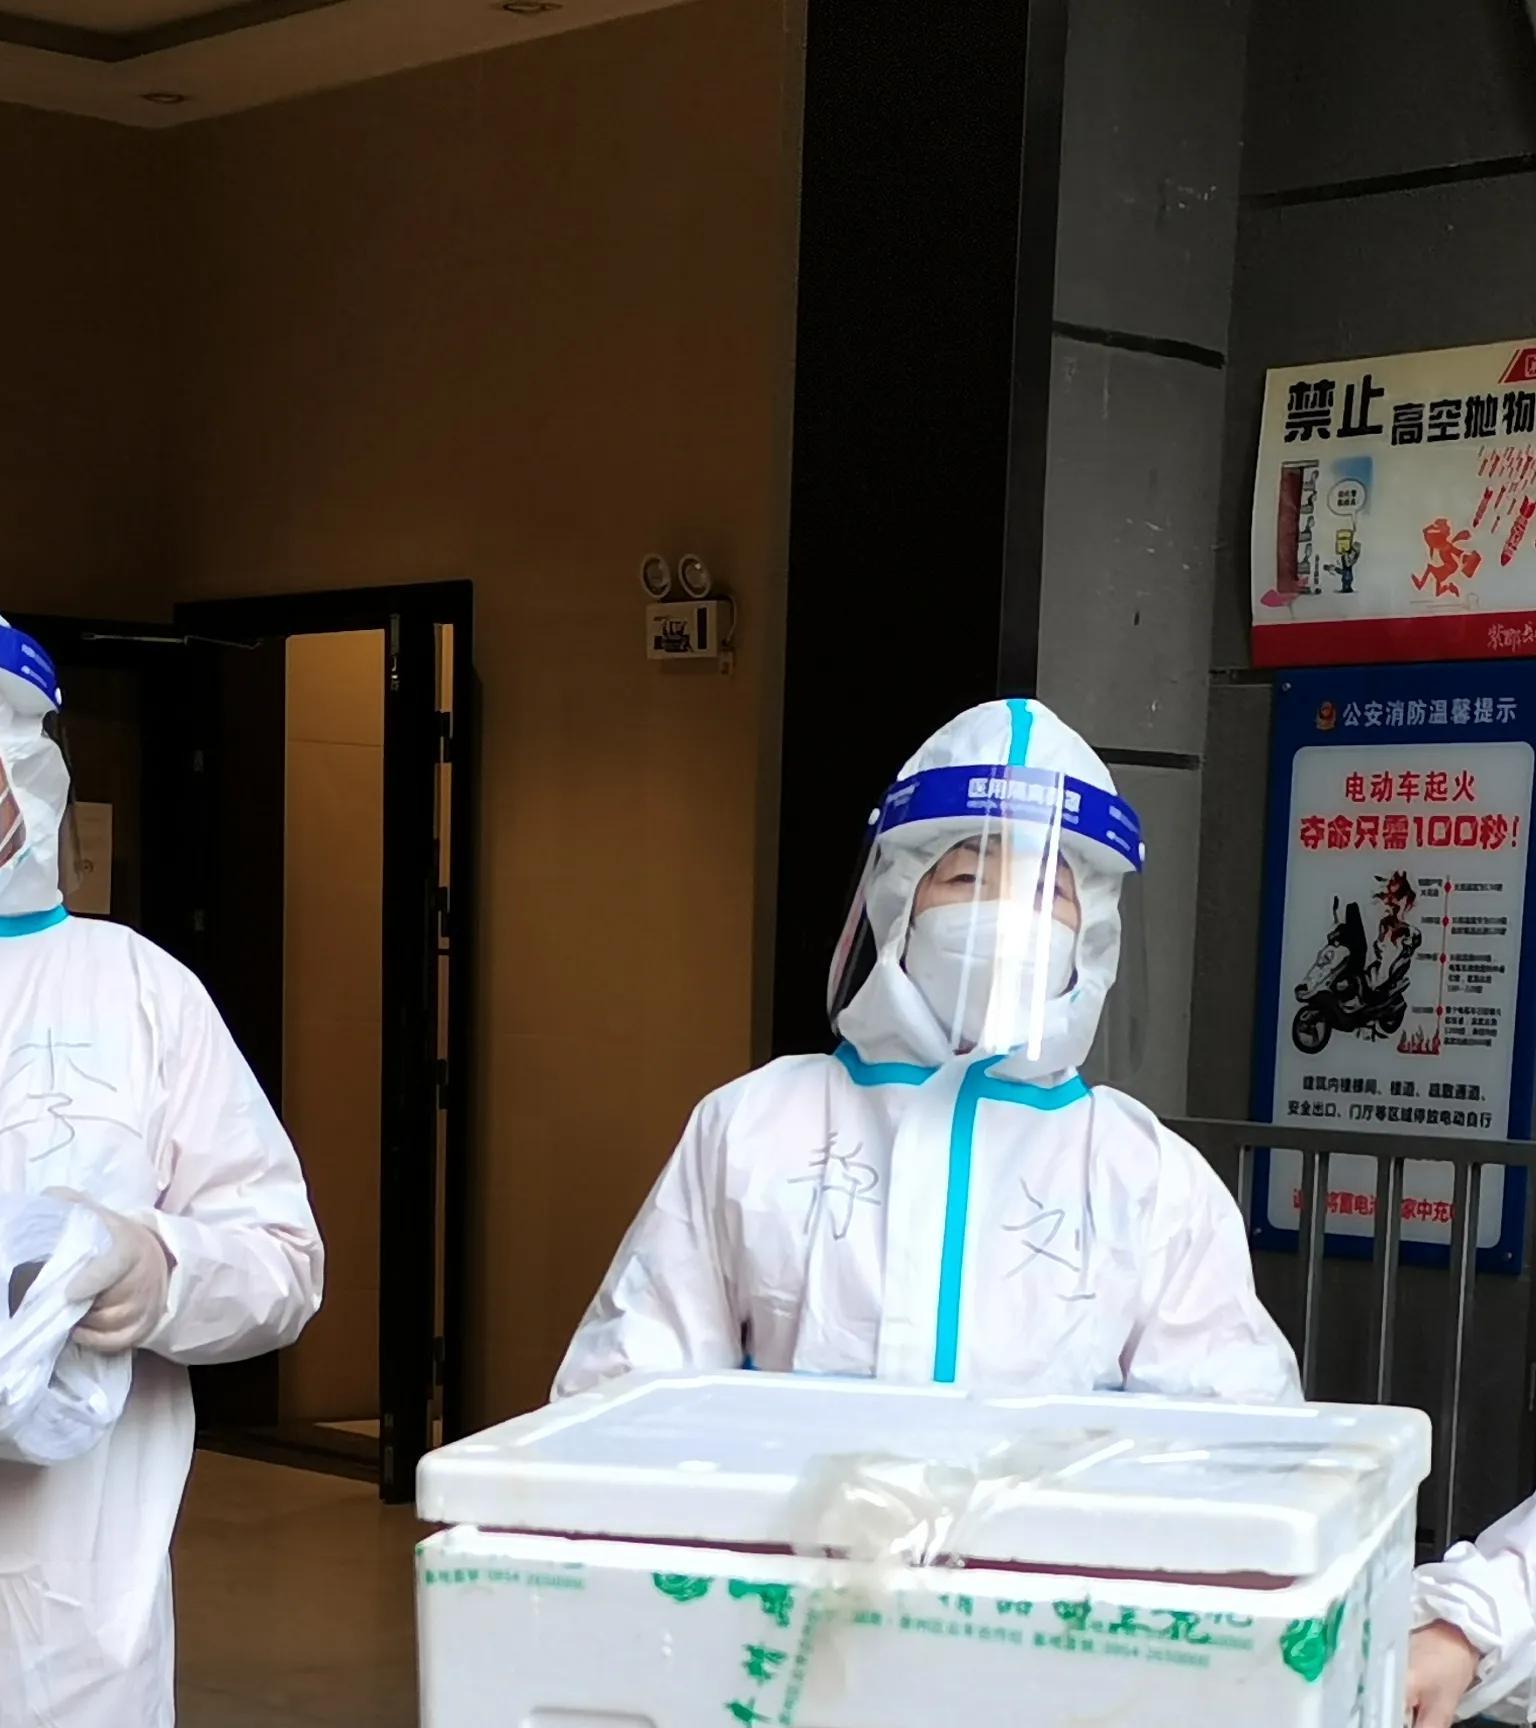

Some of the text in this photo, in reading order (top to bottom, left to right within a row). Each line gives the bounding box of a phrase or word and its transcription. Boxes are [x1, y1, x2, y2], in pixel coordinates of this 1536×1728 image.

[1284, 373, 1536, 446] 禁止 高空抛物
[1341, 697, 1517, 728] 公安消防温馨提示
[1344, 769, 1476, 804] 电动车起火
